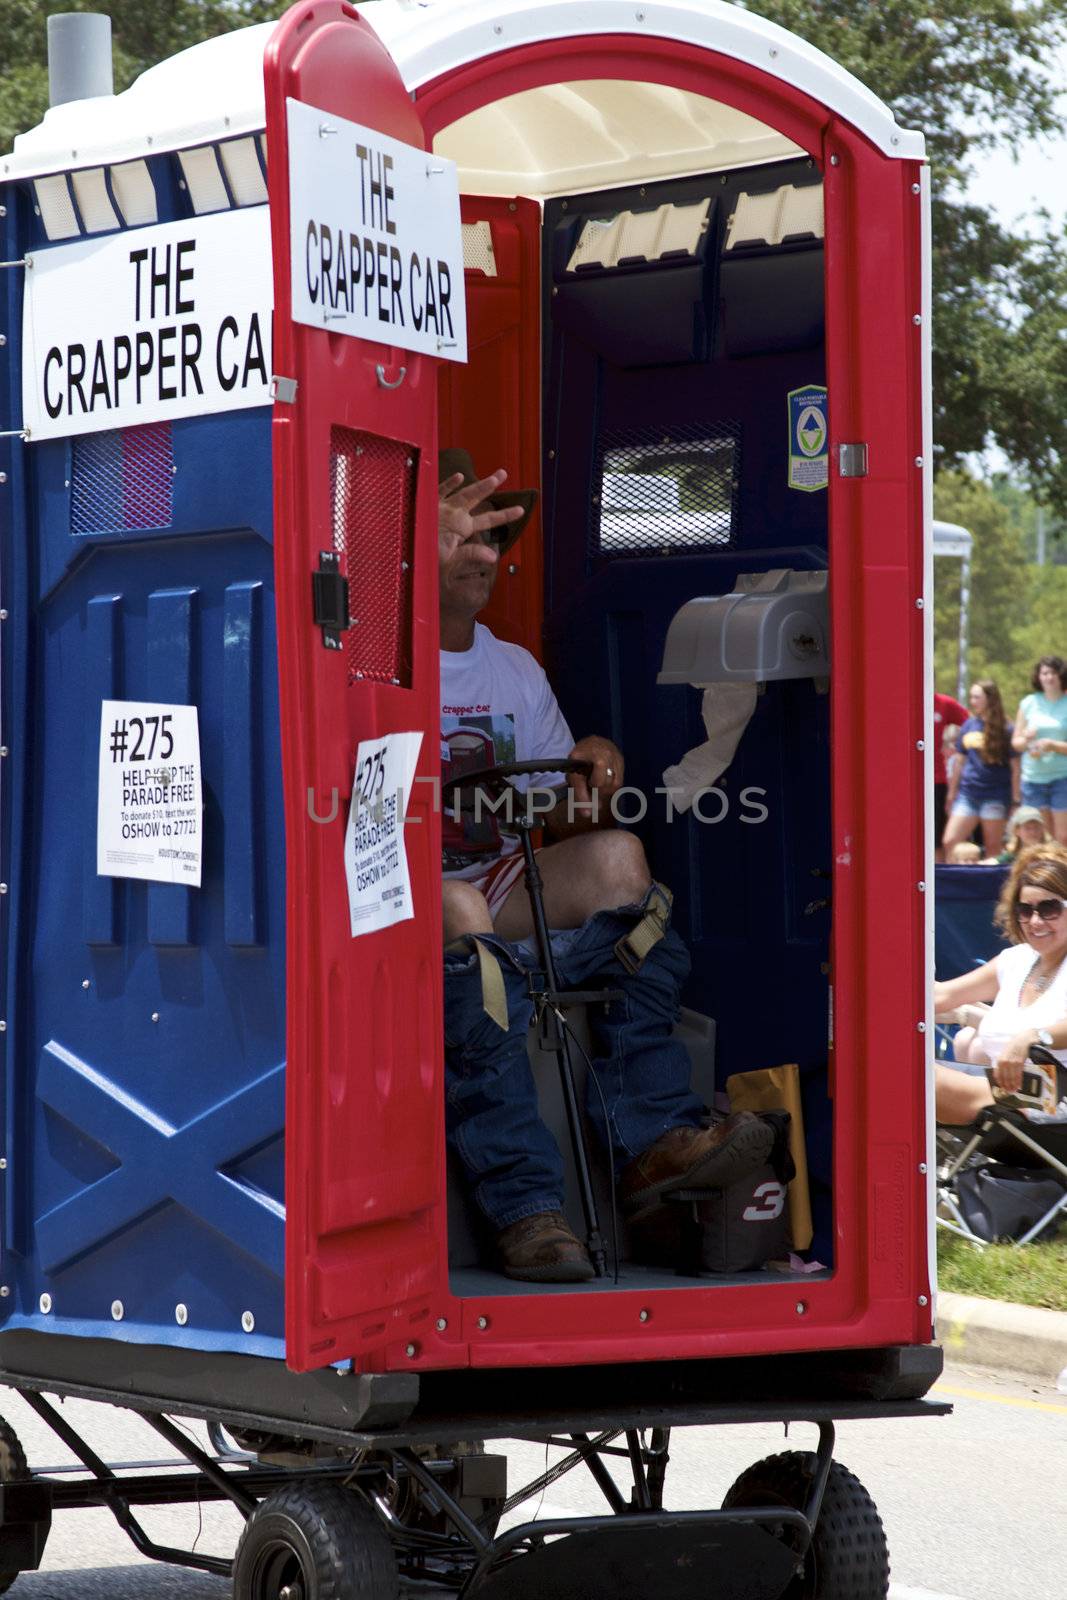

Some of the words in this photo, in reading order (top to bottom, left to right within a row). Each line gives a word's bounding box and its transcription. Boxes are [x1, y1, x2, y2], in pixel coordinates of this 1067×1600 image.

[355, 143, 397, 236] THE
[129, 239, 197, 322] THE
[306, 219, 405, 327] CRAPPER
[410, 252, 454, 338] CAR
[44, 322, 203, 419] CRAPPER
[216, 310, 274, 390] CA
[110, 714, 174, 763] #275
[122, 769, 151, 786] HELP
[179, 764, 194, 782] THE
[122, 786, 169, 807] PARADE
[121, 821, 161, 840] OSHOW
[162, 824, 171, 836] to
[742, 1180, 787, 1221] 3
